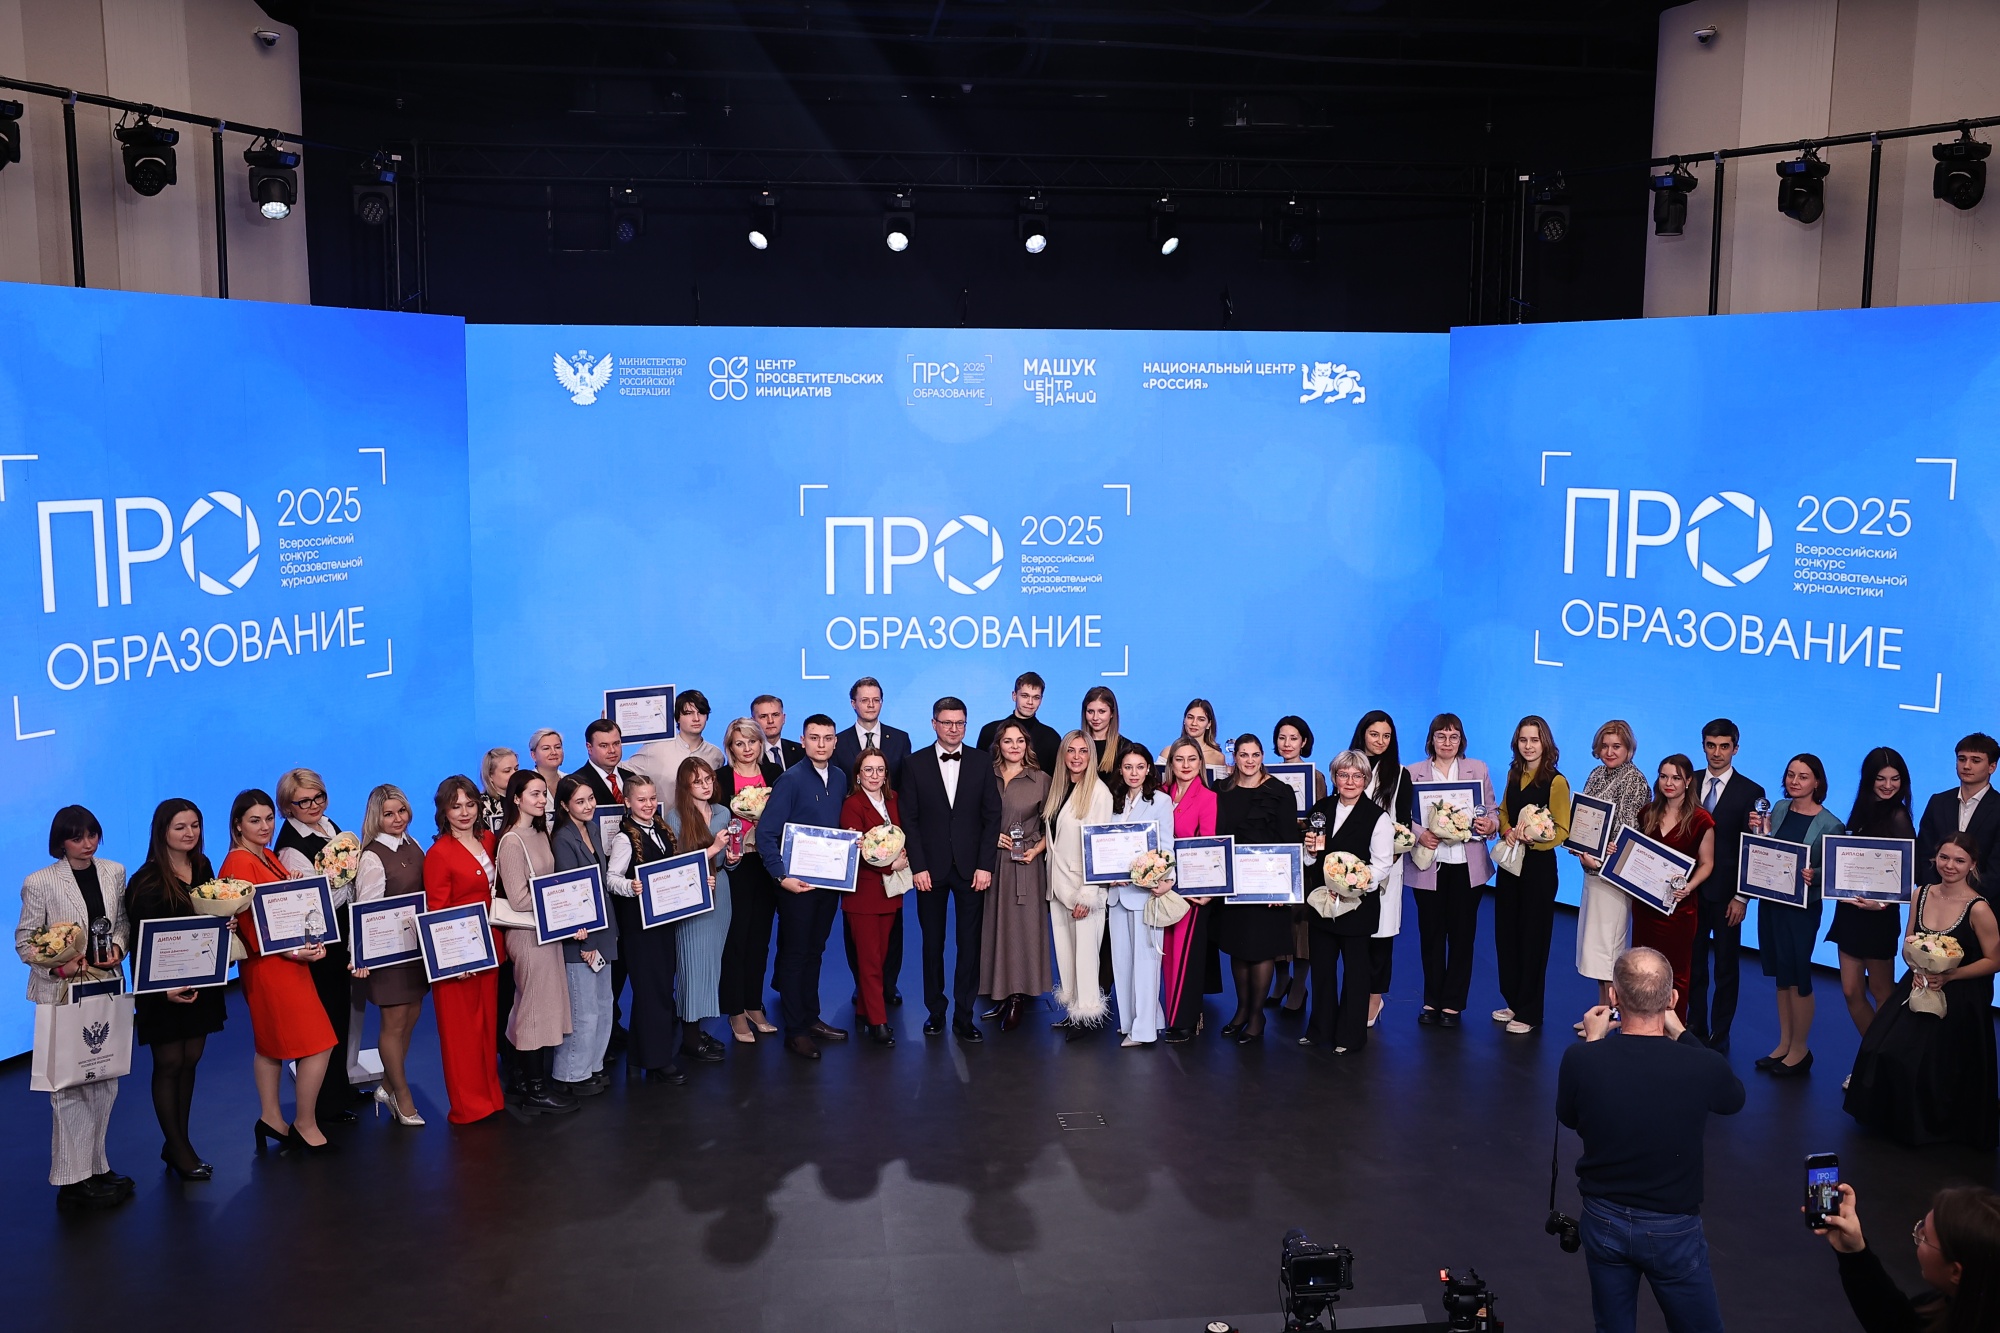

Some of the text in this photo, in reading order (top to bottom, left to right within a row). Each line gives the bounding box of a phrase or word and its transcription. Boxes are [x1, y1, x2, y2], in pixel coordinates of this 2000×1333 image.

[619, 357, 687, 366] МИНИСТЕРСТВО
[755, 359, 797, 371] ЦЕНТР
[963, 362, 986, 372] 2025
[1023, 358, 1097, 376] МАШУК
[1143, 360, 1297, 376] НАЦИОНАЛЬНЫЙ ЦЕНТР
[619, 367, 683, 376] ПРОСВЕЩЕНИЯ
[755, 372, 884, 384] ПРОСВЕТИТЕЛЬСКИХ
[913, 361, 960, 384] ПРО
[619, 376, 675, 386] РОССИЙСКОЙ
[1023, 377, 1073, 392] ЦЕНТР
[1142, 378, 1209, 390] «РОССИЯ»
[619, 387, 671, 396] ФЕДЕРАЦИИ
[755, 386, 832, 399] ИНИЦИАТИВ
[913, 388, 986, 399] ОБРАЗОВАНИЕ
[277, 486, 362, 527] 2025
[1796, 495, 1912, 537] 2025
[1021, 515, 1104, 546] 2025
[1563, 487, 1773, 588] ПРО
[279, 533, 355, 550] Всероссийский
[37, 490, 261, 613] ПРО
[280, 550, 320, 562] конкурс
[825, 514, 1004, 595] ПРО
[1795, 542, 1898, 560] Всероссийский
[280, 556, 363, 576] образовательной
[1021, 554, 1095, 565] Всероссийский
[1794, 557, 1847, 570] конкурс
[1021, 565, 1060, 575] конкурс
[1793, 568, 1908, 587] образовательной
[280, 572, 348, 588] журналистики
[1021, 574, 1103, 585] образовательной
[1021, 585, 1087, 595] журналистики
[1793, 582, 1884, 598] журналистики
[825, 614, 1103, 650] ОБРАЗОВАНИЕ
[1561, 598, 1904, 671] ОБРАЗОВАНИЕ
[46, 606, 366, 691] ОБРАЗОВАНИЕ
